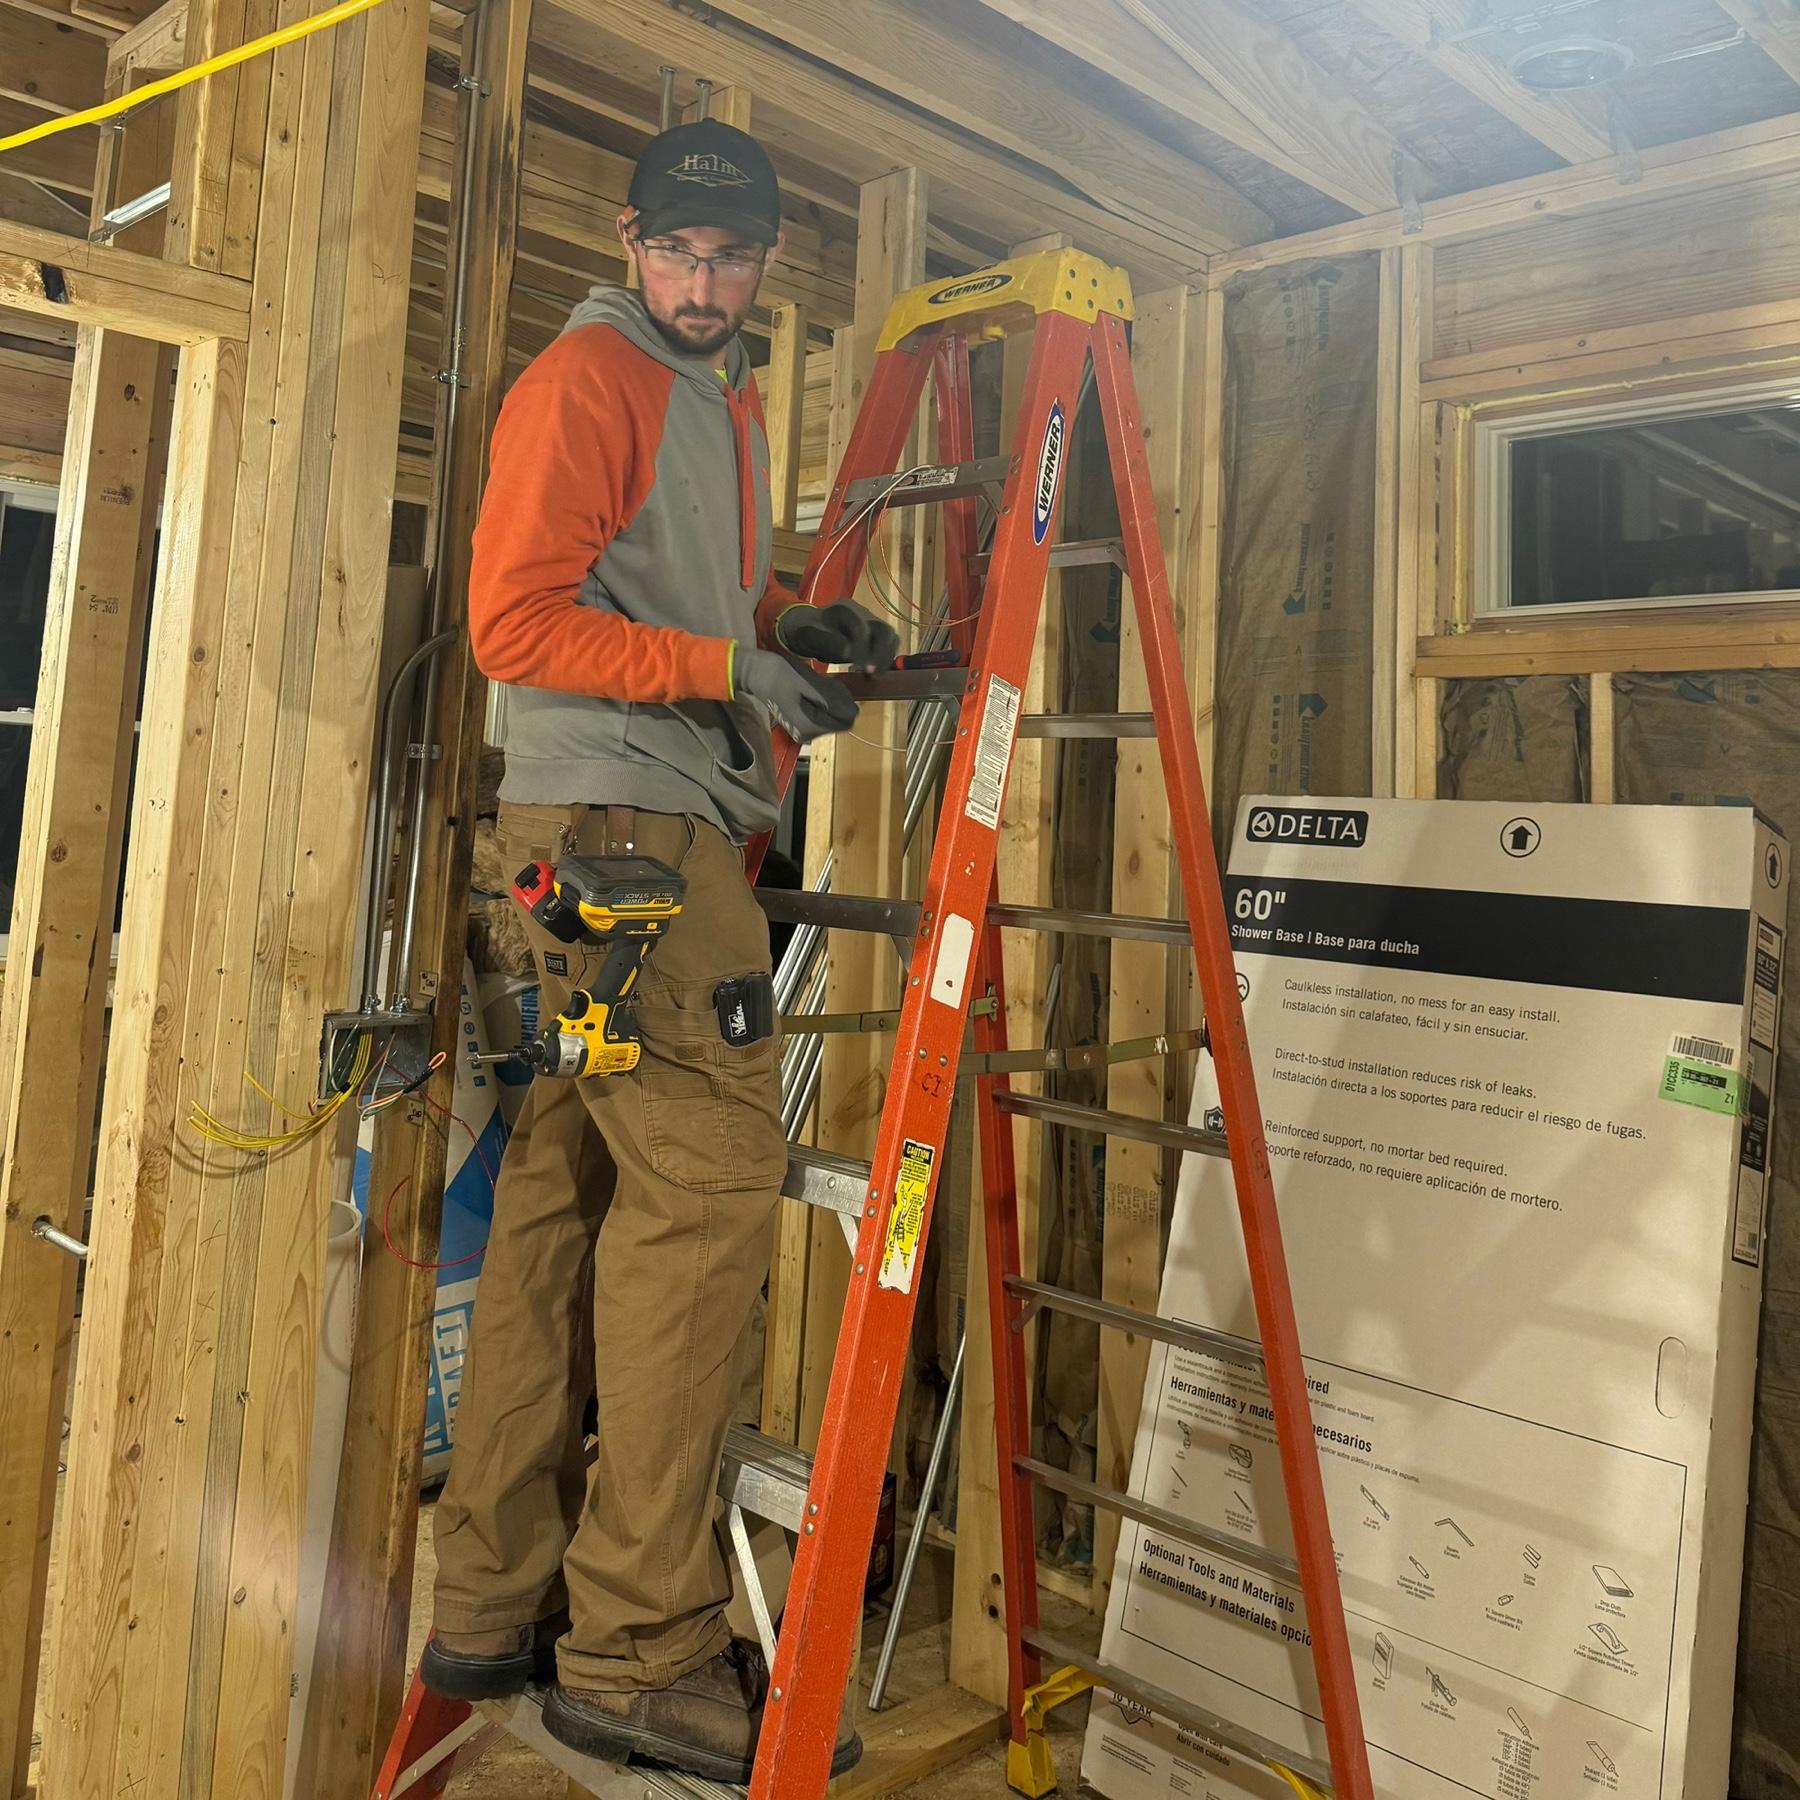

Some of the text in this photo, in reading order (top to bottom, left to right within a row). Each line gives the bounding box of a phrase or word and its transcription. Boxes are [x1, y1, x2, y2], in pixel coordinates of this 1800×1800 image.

[943, 277, 997, 300] WERNER
[1037, 423, 1060, 512] WERNER
[1276, 814, 1361, 841] DELTA
[1235, 888, 1287, 920] 60"
[1231, 925, 1272, 941] Shower
[1275, 928, 1304, 943] Base
[1314, 931, 1345, 947] Base
[1347, 937, 1376, 951] para
[1380, 938, 1420, 955] ducha
[1282, 999, 1529, 1042] Instalación sin calafateo, fácil y sin ensuciar.
[1284, 978, 1560, 1024] Caulkless installation, no mess for an easy install.
[1274, 1048, 1537, 1099] Direct-to-stud installation reduces risk of leaks.
[1272, 1067, 1646, 1142] Instalación directa a los soportes para reducir el riesgo de fugas.
[1265, 1119, 1508, 1177] Reinforced support, no mortar bed required.
[1302, 1150, 1355, 1172] reforzado,
[1359, 1162, 1374, 1175] no
[1375, 1166, 1423, 1184] requiere
[1425, 1175, 1488, 1197] aplicación
[1490, 1186, 1507, 1201] de
[1510, 1191, 1563, 1212] mortero.
[1171, 1376, 1237, 1408] Herramientas
[1239, 1401, 1247, 1414] y
[1248, 1404, 1275, 1421] mate
[1143, 1539, 1295, 1612] Optional Tools and Materials
[1138, 1562, 1313, 1646] Herramientas y materiales opcio
